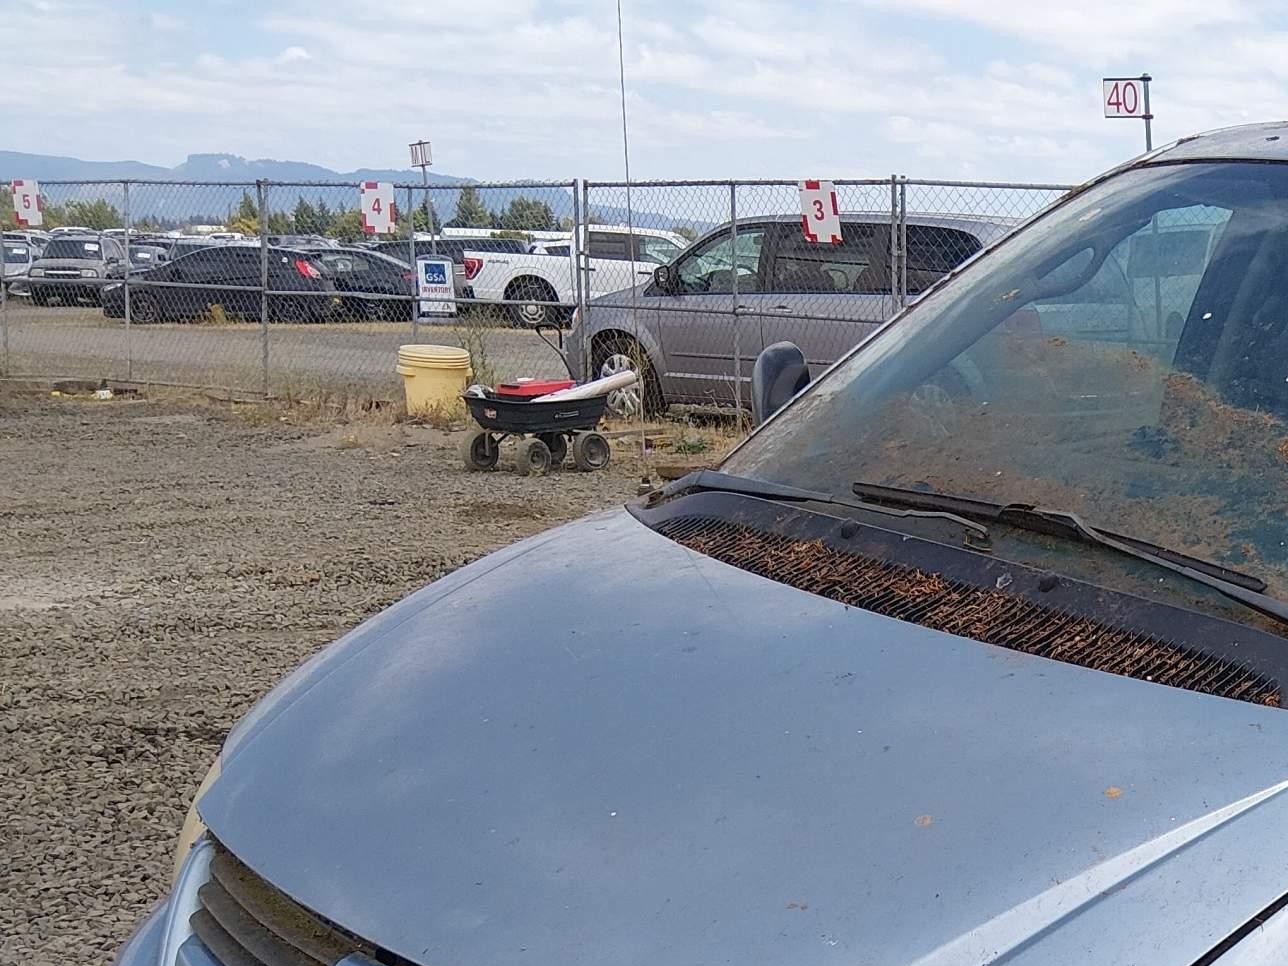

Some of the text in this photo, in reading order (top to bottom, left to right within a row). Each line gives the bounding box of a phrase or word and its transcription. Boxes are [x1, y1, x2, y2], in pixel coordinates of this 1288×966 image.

[1106, 81, 1138, 114] 40
[22, 193, 31, 210] 5
[371, 197, 383, 215] 4
[812, 199, 825, 221] 3
[426, 272, 446, 282] GSA
